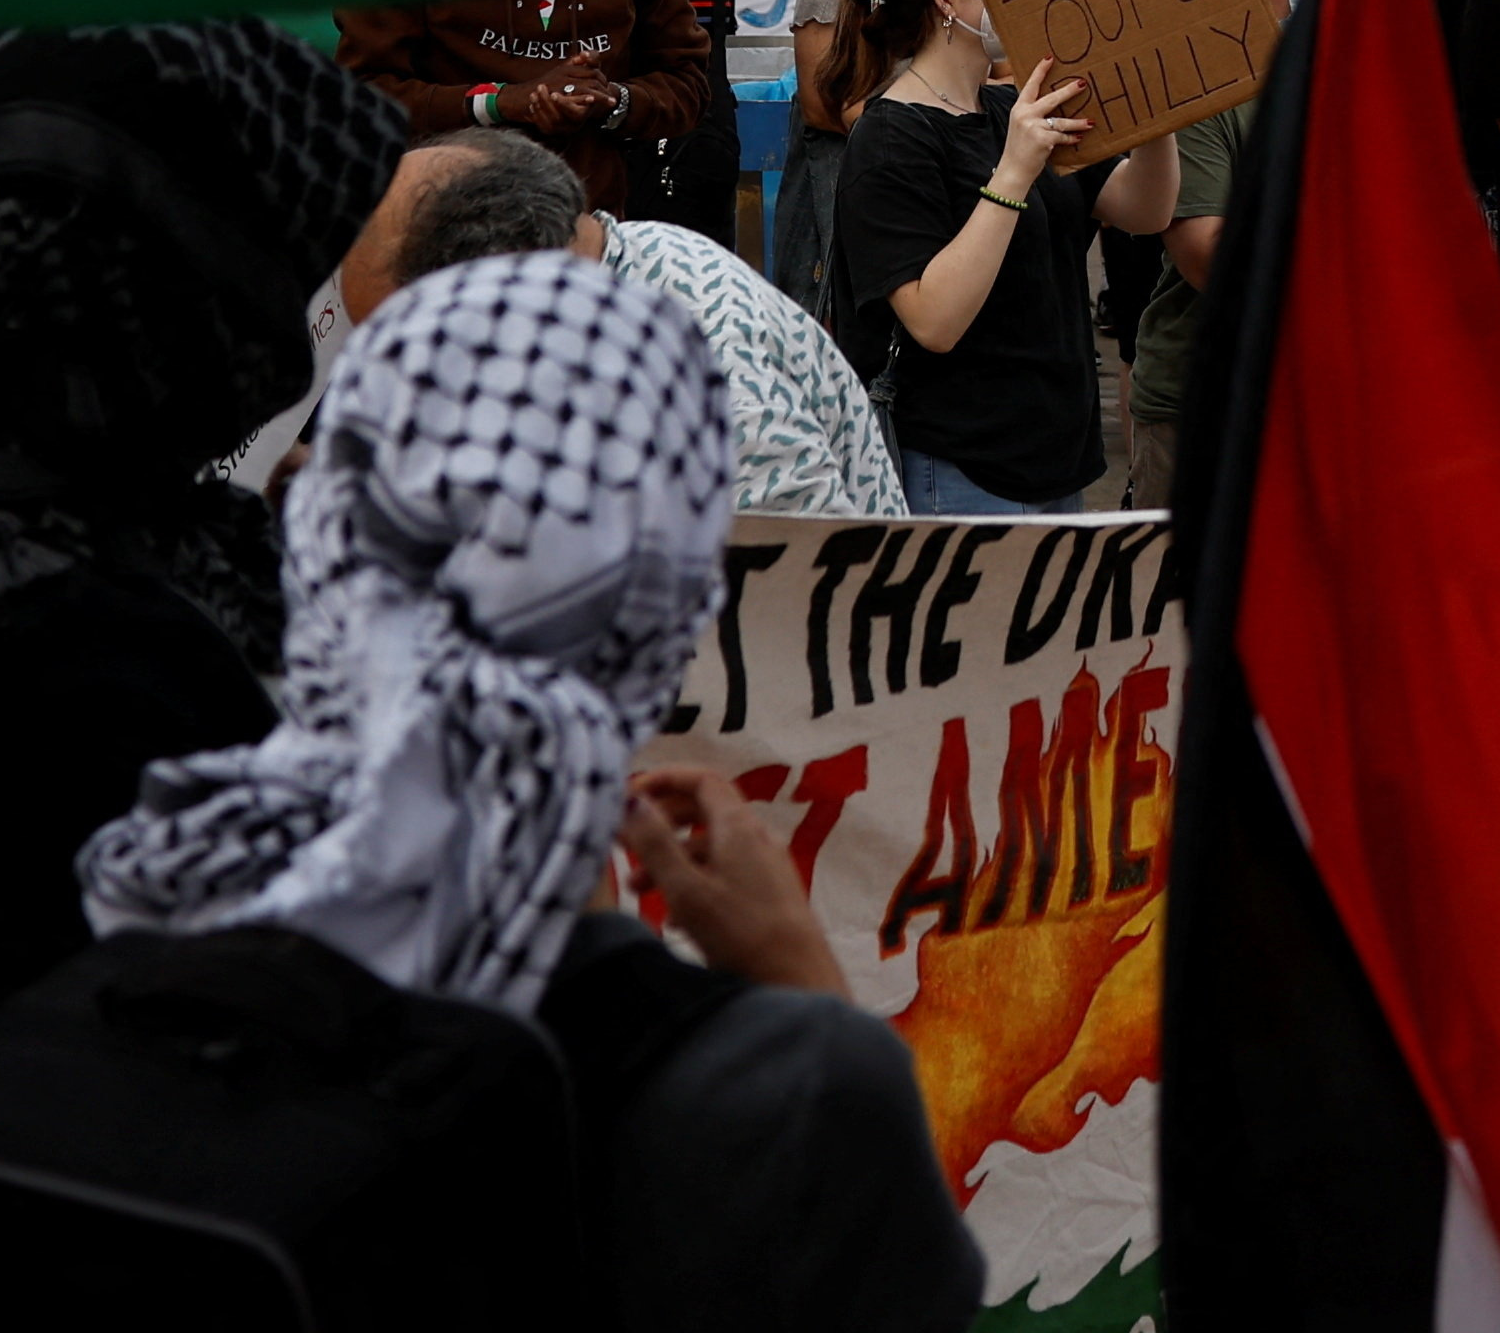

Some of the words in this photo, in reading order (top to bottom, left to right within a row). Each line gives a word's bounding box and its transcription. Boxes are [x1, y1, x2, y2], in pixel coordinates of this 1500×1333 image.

[479, 28, 612, 61] PALESTNE
[1051, 9, 1256, 151] PHILLY
[806, 525, 1014, 719] THE
